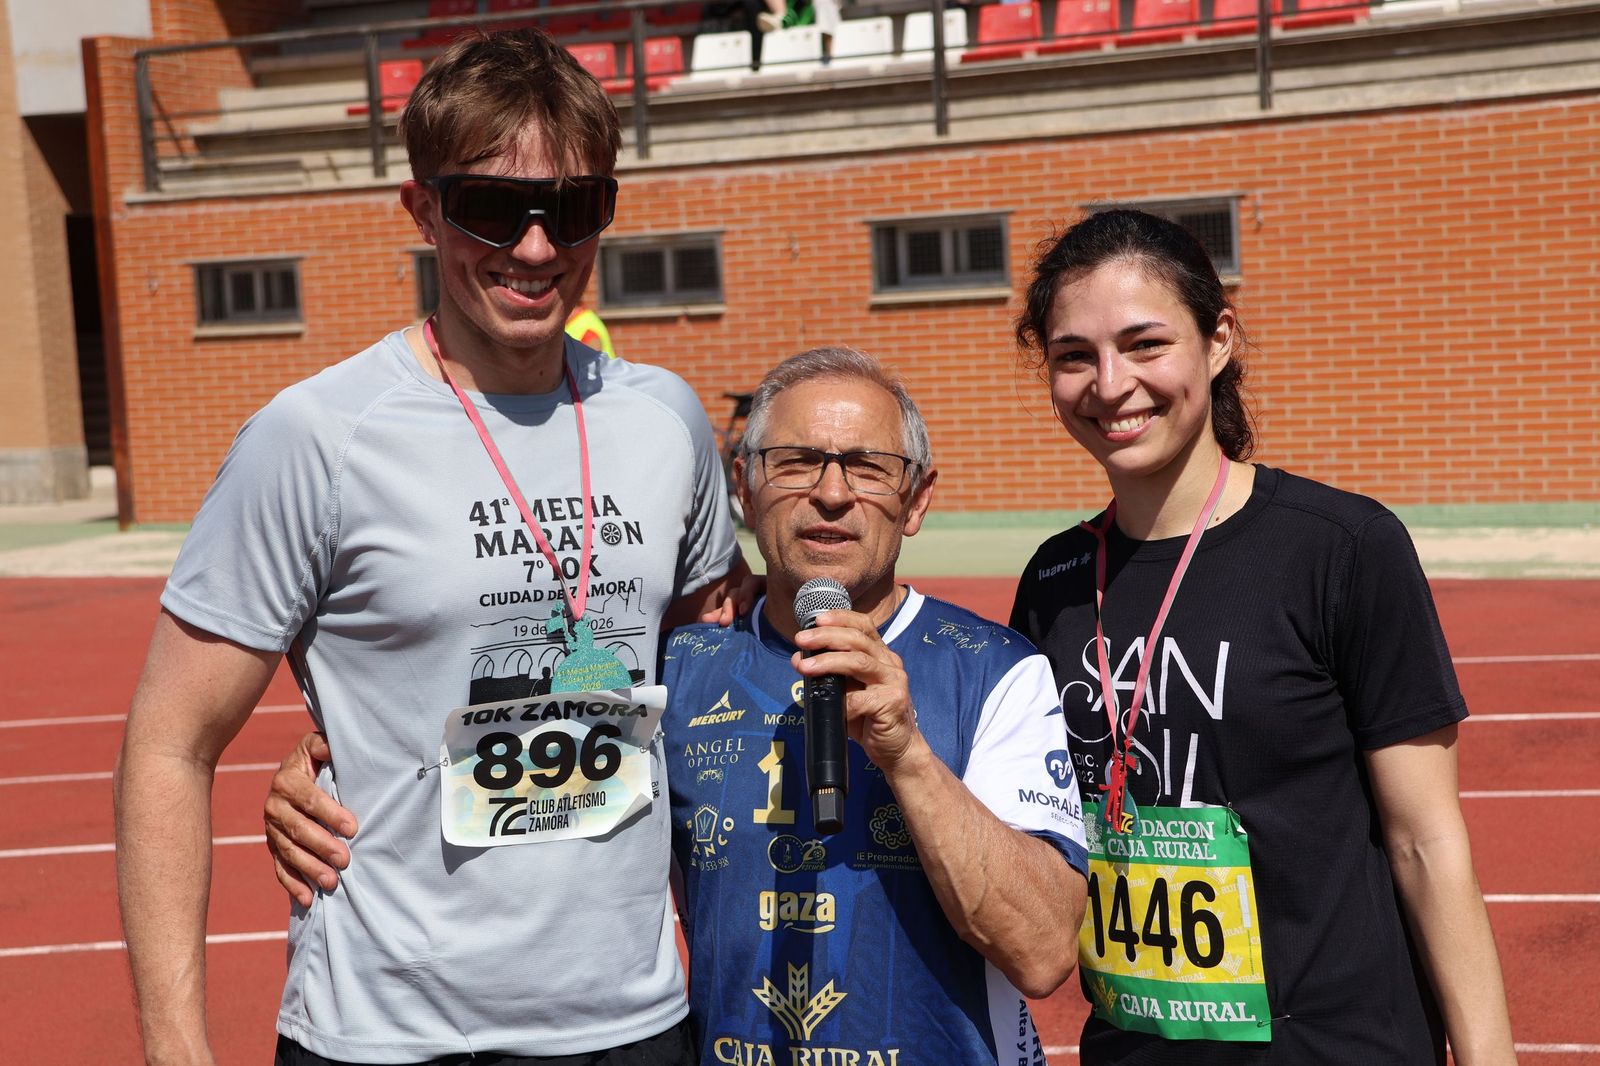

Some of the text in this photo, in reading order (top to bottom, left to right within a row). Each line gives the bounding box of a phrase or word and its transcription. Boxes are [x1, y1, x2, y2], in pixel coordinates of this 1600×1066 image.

[520, 495, 622, 524] MEDIA
[479, 579, 637, 607] CIUDAD DE ZMORA
[512, 616, 614, 637] 19 de 026
[1061, 636, 1230, 743] SAN
[461, 700, 649, 727] 10K ZAMORA
[688, 709, 746, 728] MERCURY
[473, 724, 622, 792] 896
[684, 738, 746, 757] ANGEL
[688, 753, 739, 768] OPTICO
[1076, 771, 1095, 784] 022
[529, 790, 607, 815] CLUB ATLETISMO
[1018, 788, 1084, 823] MORALE
[528, 814, 570, 833] ZAMORA
[1106, 819, 1215, 841] DACION
[1107, 838, 1217, 860] CAJA RURAL
[759, 890, 836, 931] gaza
[1087, 872, 1225, 969] 1446
[1018, 999, 1028, 1037] Alta
[1119, 993, 1257, 1023] CAJA RURAL
[714, 1037, 777, 1066] CAJA
